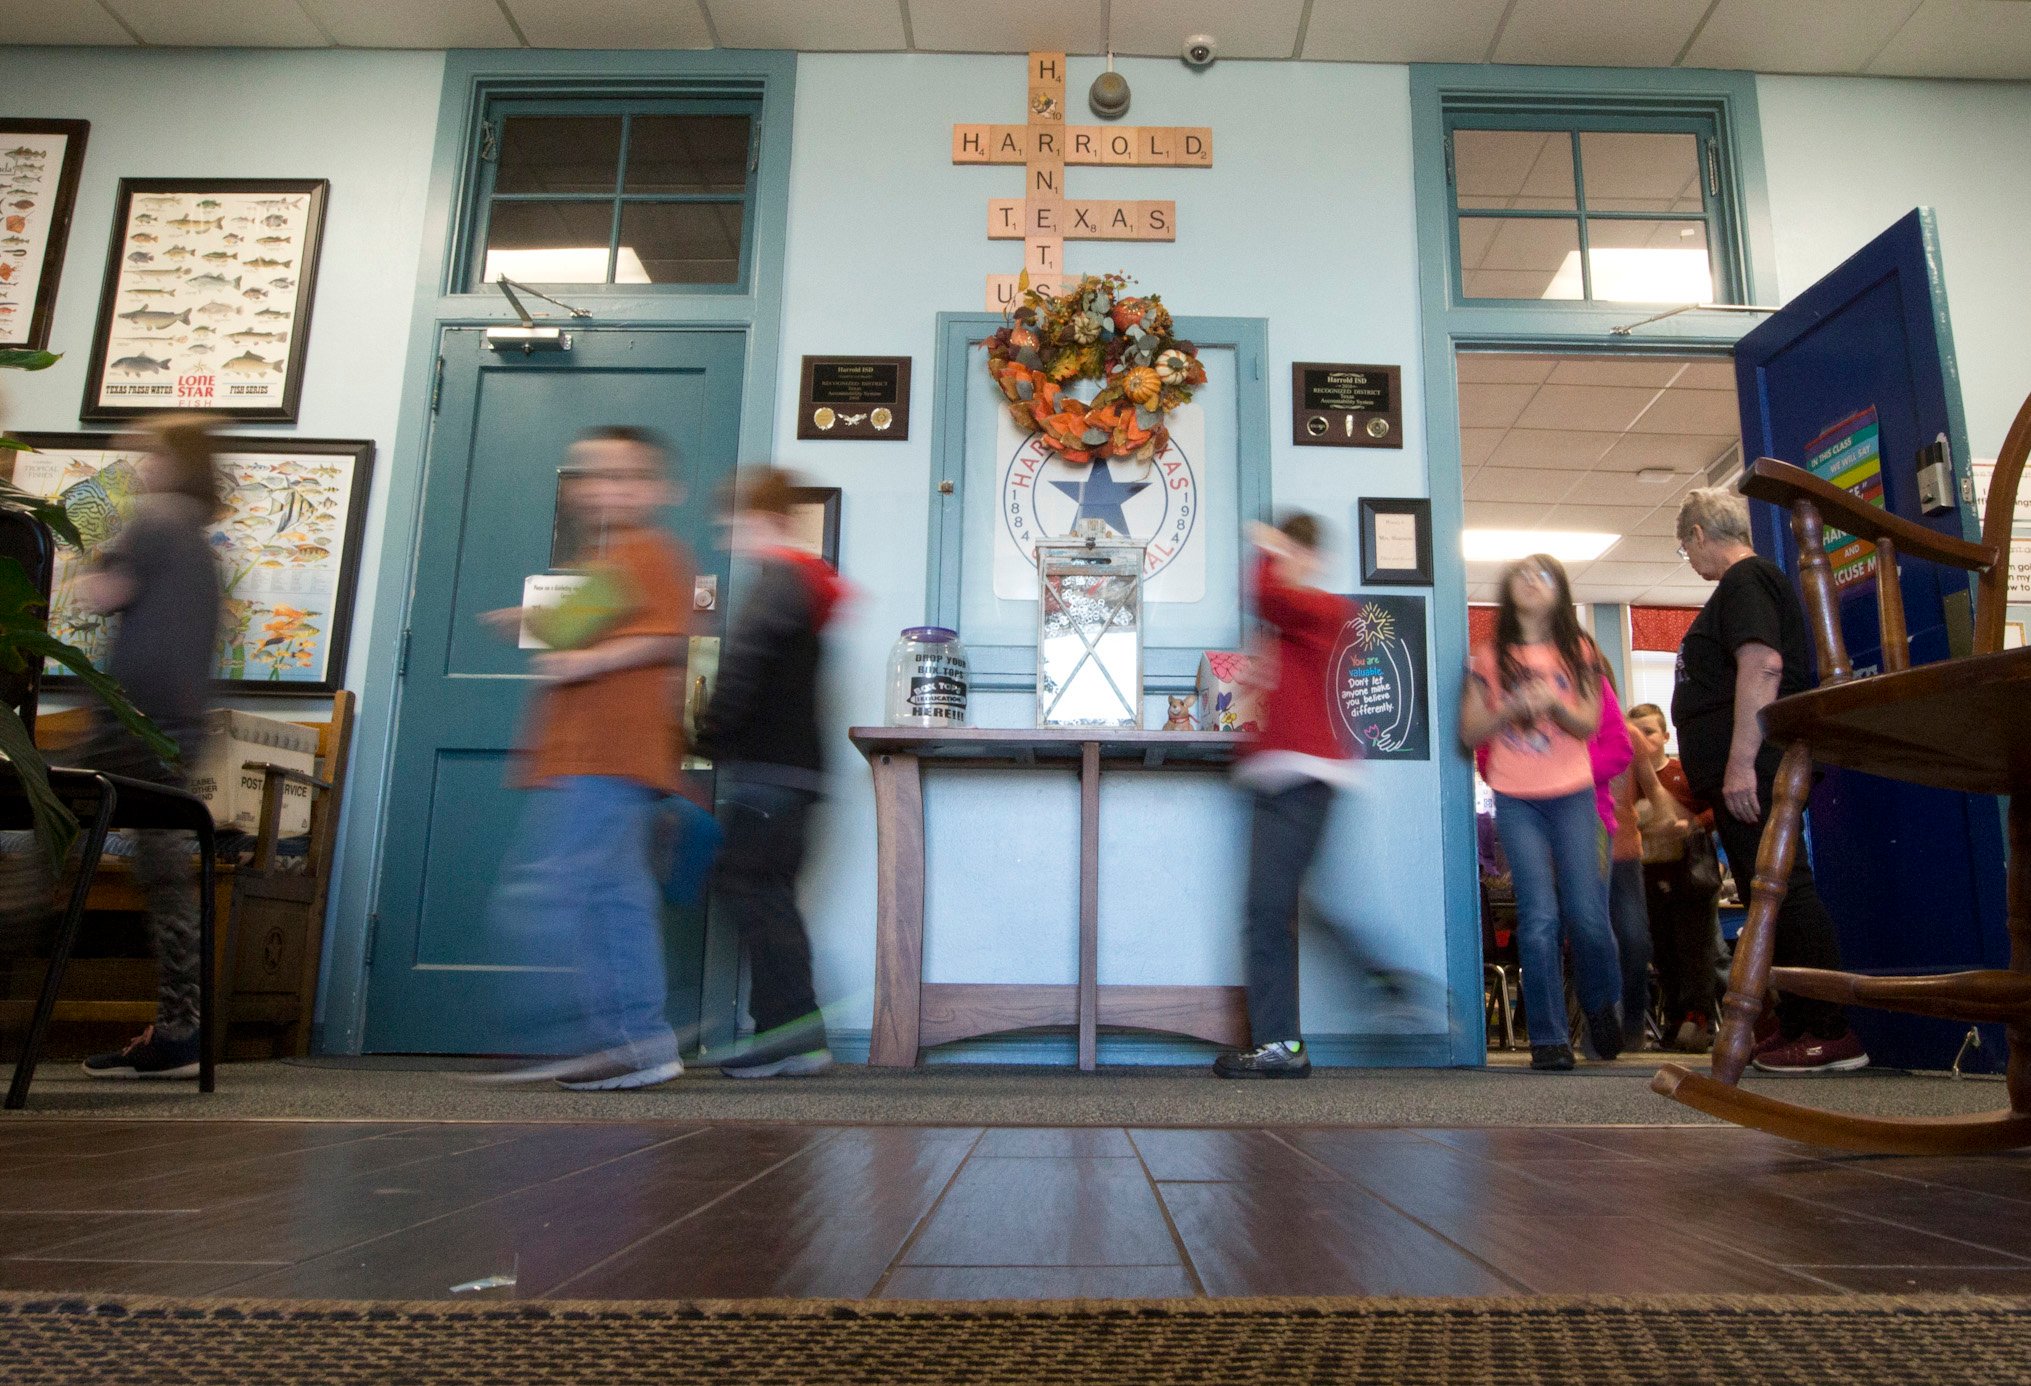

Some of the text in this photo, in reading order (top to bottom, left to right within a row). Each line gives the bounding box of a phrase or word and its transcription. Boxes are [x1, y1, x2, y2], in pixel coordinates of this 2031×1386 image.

[963, 132, 1203, 156] HARROLD
[999, 207, 1166, 230] TEXAS
[177, 375, 215, 386] LONE
[1327, 376, 1367, 385] Harrold ISD
[106, 385, 173, 395] TEXAS FRESH WATER
[177, 387, 214, 398] STAR
[230, 386, 268, 395] FISH SERIES
[179, 399, 213, 407] FISH
[1811, 436, 1852, 468] IN THIS CLASS
[1830, 443, 1872, 473] WE WILL SAY
[1845, 544, 1860, 558] AND
[915, 654, 966, 668] DROP YOUR
[1350, 655, 1380, 667] You are
[943, 667, 964, 679] TOPS
[1349, 666, 1384, 677] valuable.
[1348, 675, 1384, 688] Don't let
[1341, 683, 1391, 699] anyone make
[1345, 692, 1390, 709] you believe
[1351, 701, 1394, 717] differently.
